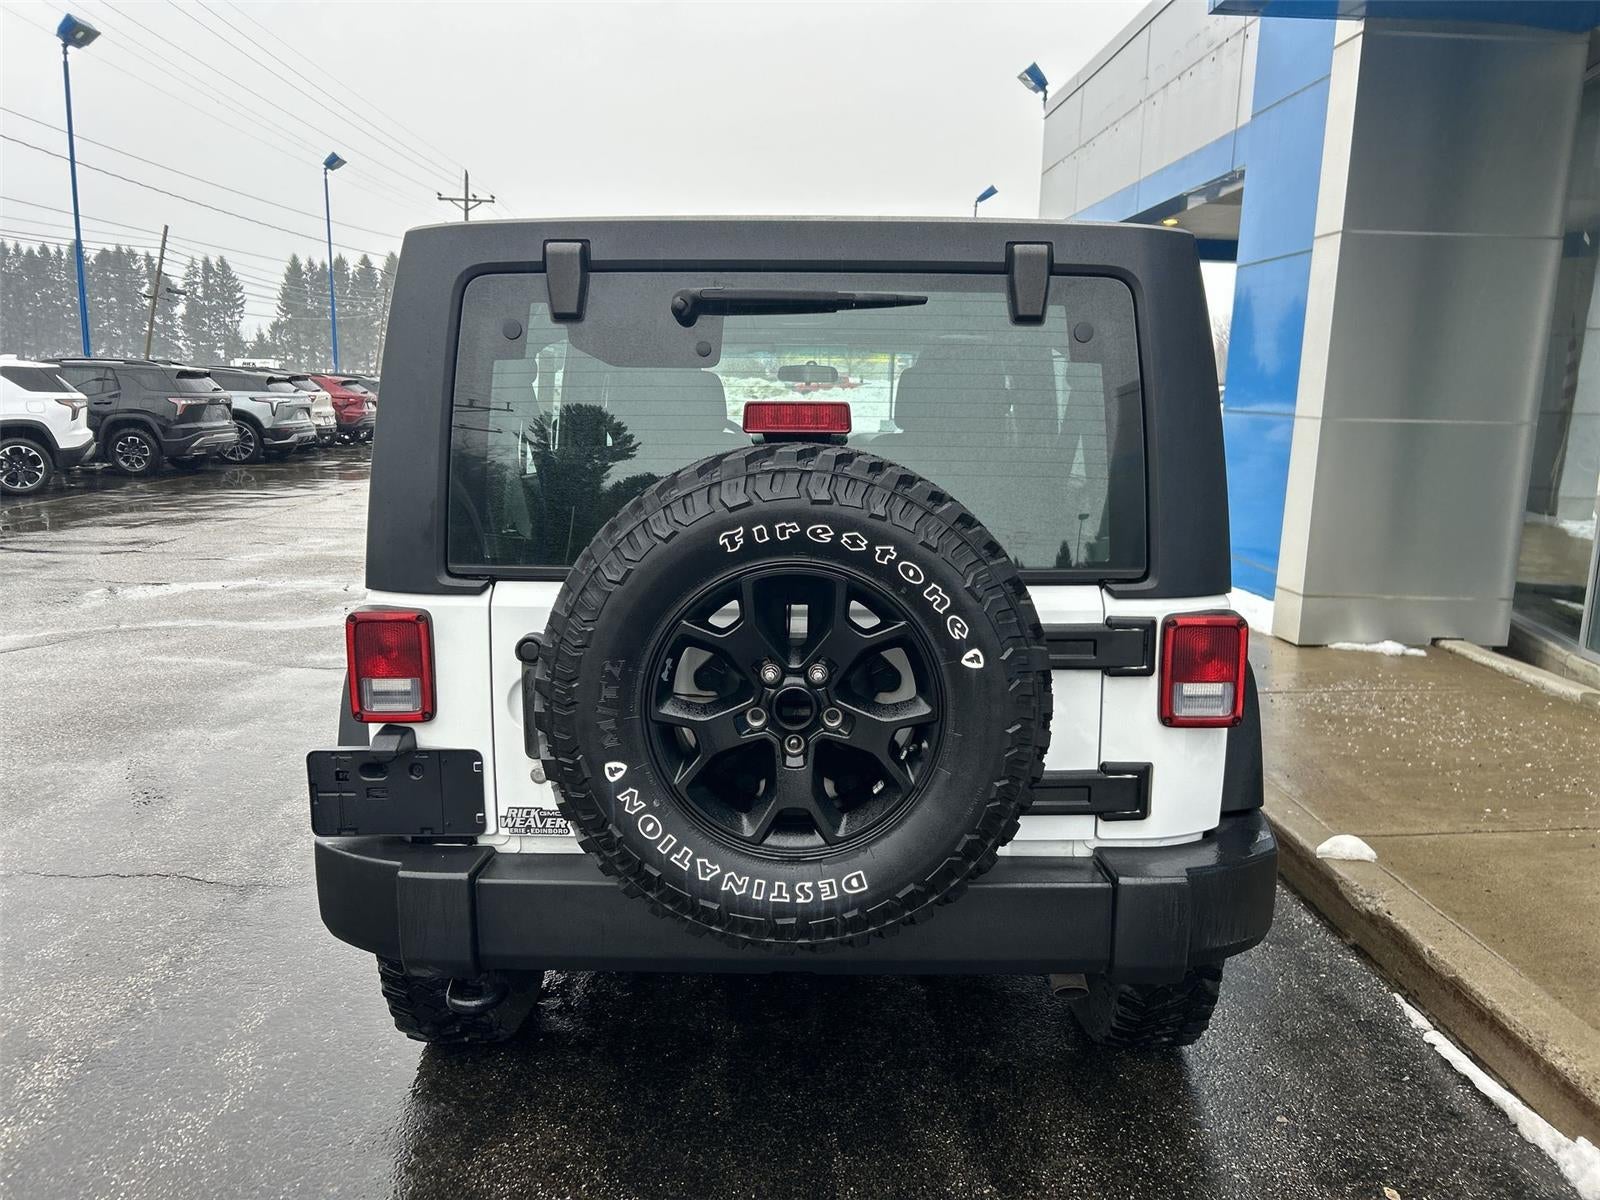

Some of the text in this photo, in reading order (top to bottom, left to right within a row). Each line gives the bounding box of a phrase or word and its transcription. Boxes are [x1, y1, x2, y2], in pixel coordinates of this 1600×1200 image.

[719, 522, 969, 640] Firestone
[500, 817, 567, 828] WEAVER
[507, 808, 541, 818] RICK
[616, 787, 869, 903] DESTINATION
